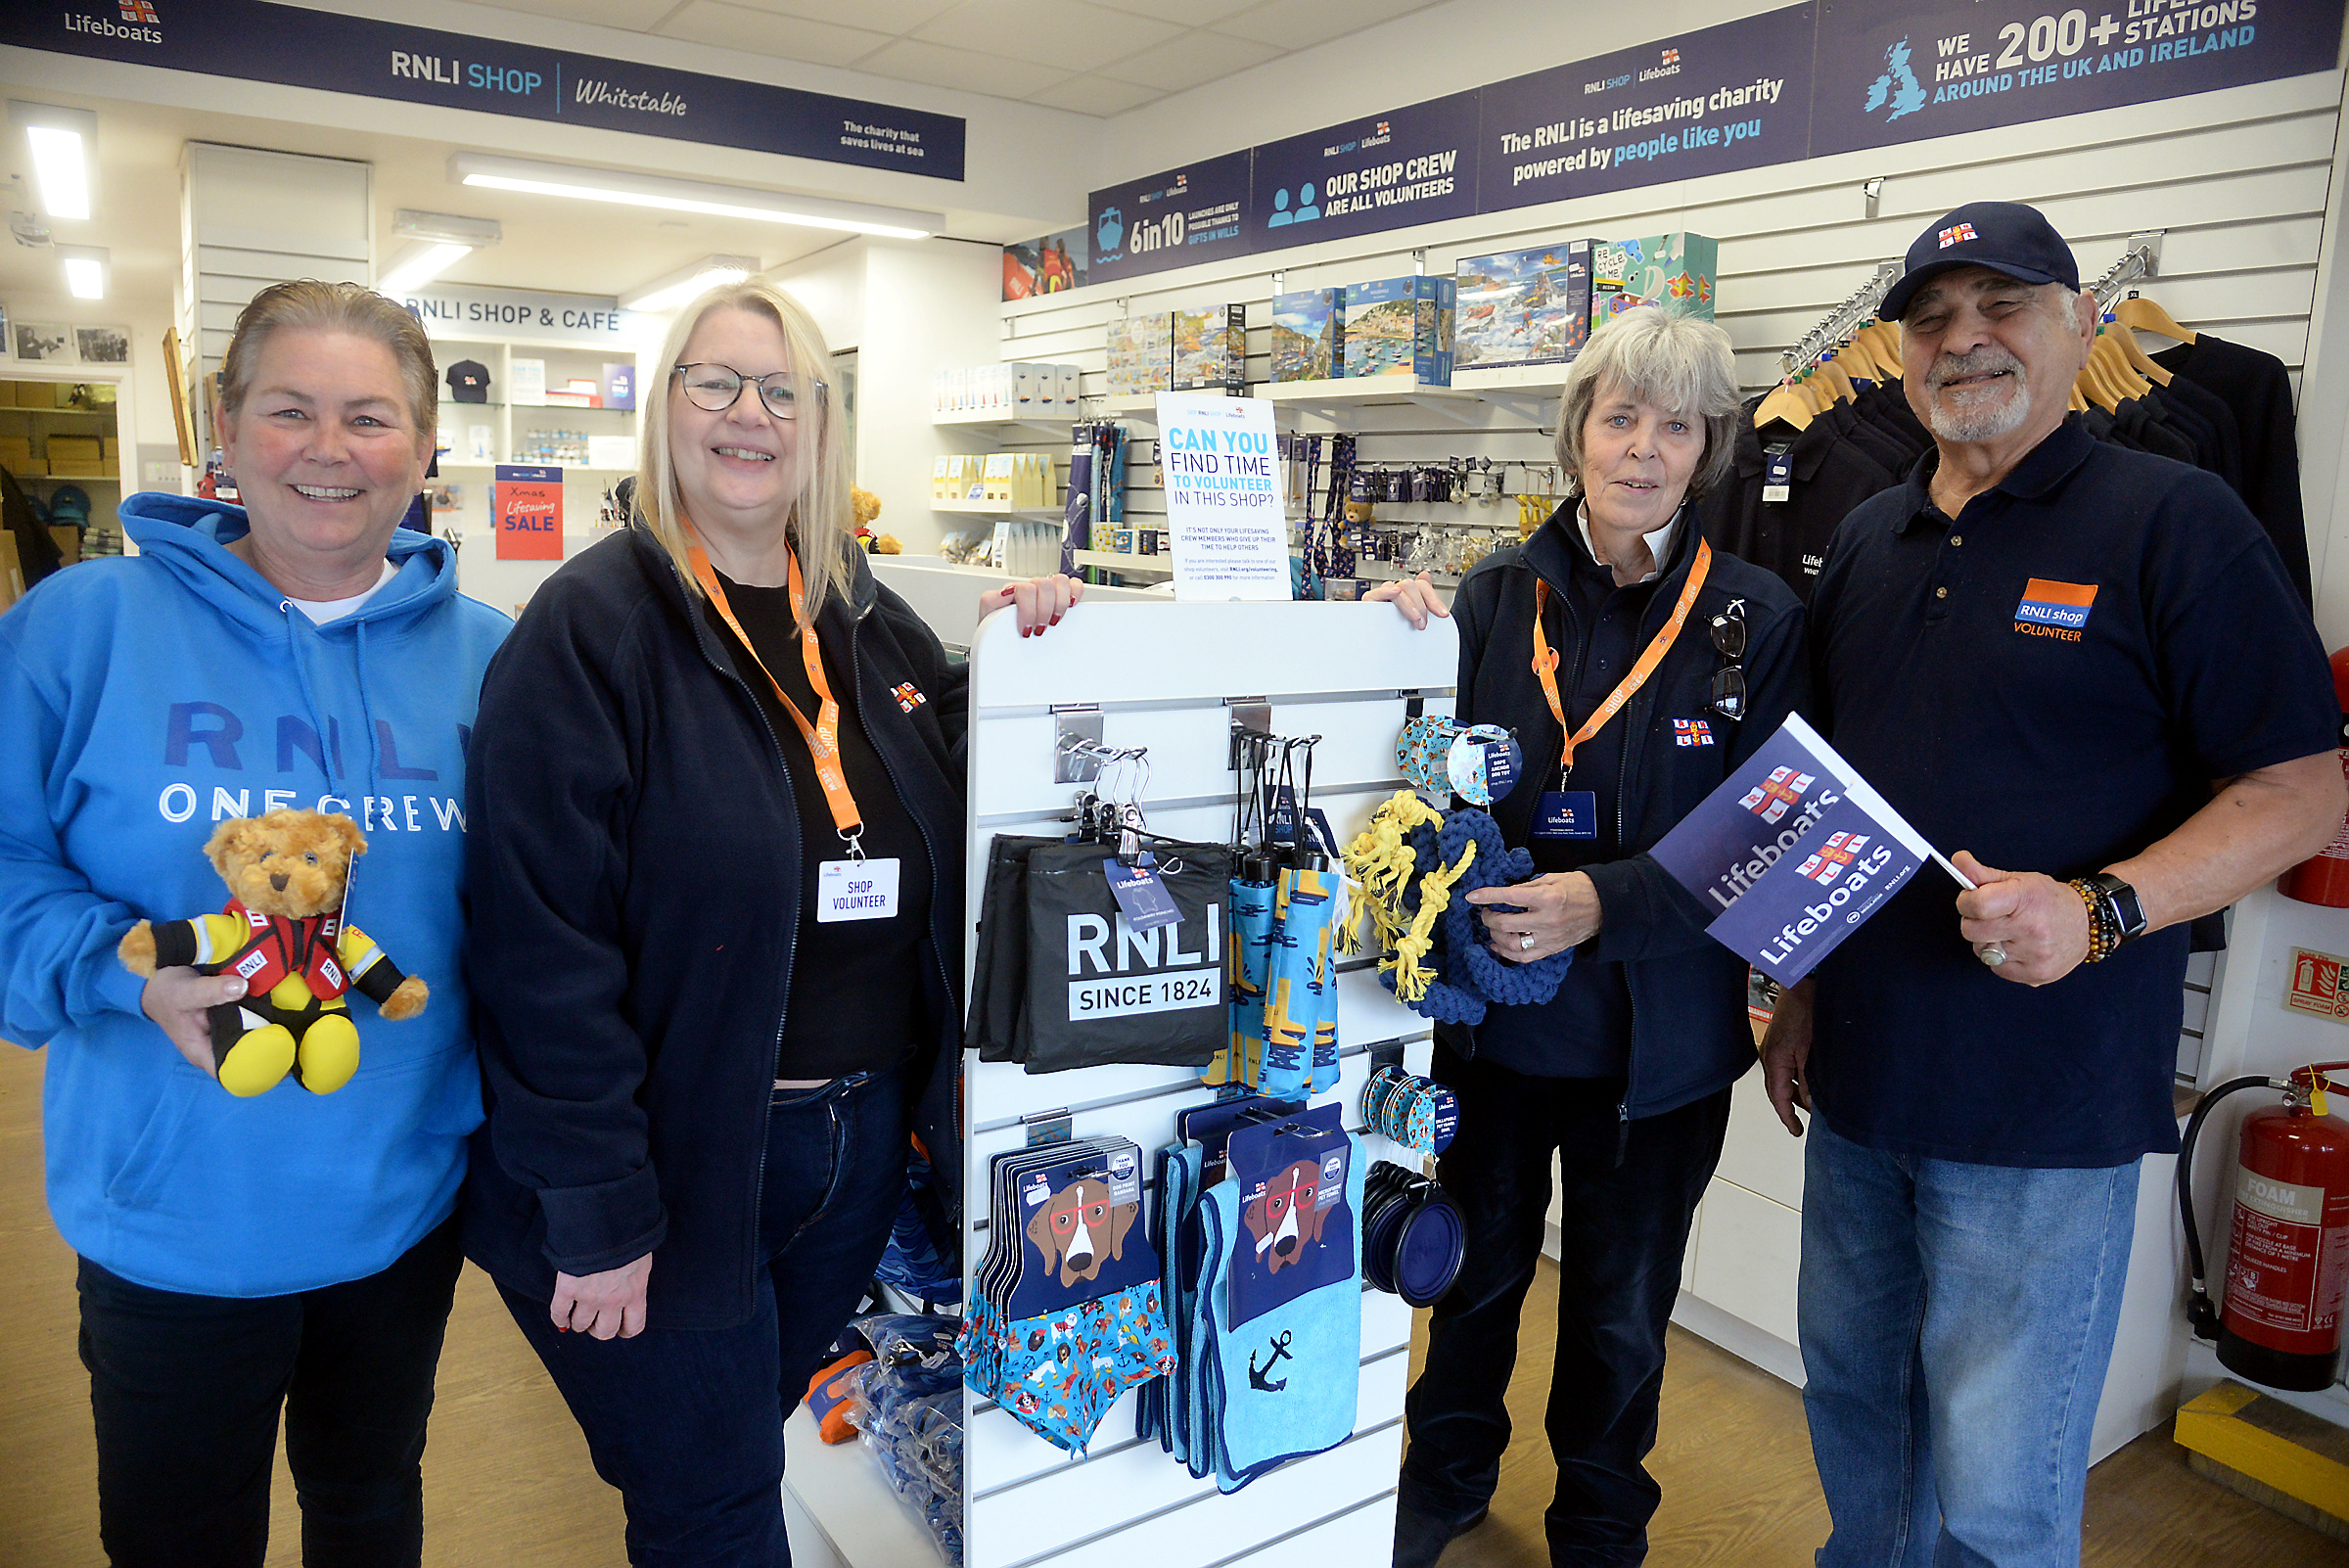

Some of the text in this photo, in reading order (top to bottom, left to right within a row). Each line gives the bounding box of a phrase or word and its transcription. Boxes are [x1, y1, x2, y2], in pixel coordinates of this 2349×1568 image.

[65, 13, 162, 44] Lifeboats
[2124, 0, 2257, 44] STATIONS
[1996, 9, 2120, 69] 200+
[1933, 24, 2255, 105] AROUND THE UK AND IRELAND
[1935, 32, 1991, 82] WE HAVE
[392, 50, 542, 96] RNLI SHOP
[1585, 73, 1631, 95] RNLI SHOP
[1638, 64, 1681, 82] Lifeboats
[575, 77, 687, 116] Whitstable
[1500, 76, 1783, 155] The RNLI is a lifesaving charity
[844, 120, 920, 142] The charity that
[1361, 134, 1390, 149] Lifeboats
[840, 135, 924, 157] saves lives at sea
[1339, 141, 1357, 154] SHOP
[1513, 117, 1761, 185] powered by people like you
[1326, 149, 1457, 198] OUR SHOP CREW
[1225, 201, 1239, 211] ONLY
[1324, 176, 1454, 217] ARE ALL VOLUNTEERS
[1188, 225, 1239, 245] GIFTS IN WILLS
[469, 301, 531, 325] SHOP
[539, 307, 554, 327] &
[562, 306, 620, 331] CAFÉ
[1169, 427, 1268, 454] CAN YOU
[1171, 452, 1271, 477] FIND TIME
[510, 486, 545, 497] Xmas
[1174, 475, 1272, 491] TO VOLUNTEER
[506, 500, 555, 515] Lifesaving
[1174, 490, 1274, 508] IN THIS SHOP?
[505, 515, 555, 531] SALE
[1687, 584, 1697, 603] CREW
[1675, 600, 1686, 626] SHOP
[2020, 605, 2083, 624] RNLI shop
[2013, 622, 2082, 642] VOLUNTEER
[1630, 672, 1643, 691] CREW
[1544, 686, 1560, 710] SHOP
[1605, 688, 1625, 715] SHOP
[806, 732, 830, 760] SHOP
[819, 767, 838, 791] CREW
[316, 794, 467, 833] CREW
[848, 880, 873, 894] SHOP
[1116, 877, 1154, 890] Lifeboats
[1884, 864, 1911, 891] RNLI.org
[833, 895, 886, 909] VOLUNTEER
[1759, 844, 1892, 965] Lifeboats
[1067, 902, 1221, 975] RNLI
[240, 954, 263, 975] RNLI
[323, 962, 341, 986] RNLI
[1080, 978, 1212, 1011] SINCE 1824
[1242, 1191, 1267, 1203] Lifeboats
[2248, 1177, 2296, 1206] FOAM
[2250, 1195, 2309, 1216] EXTINGUISHER
[2263, 1262, 2287, 1273] HANDLES
